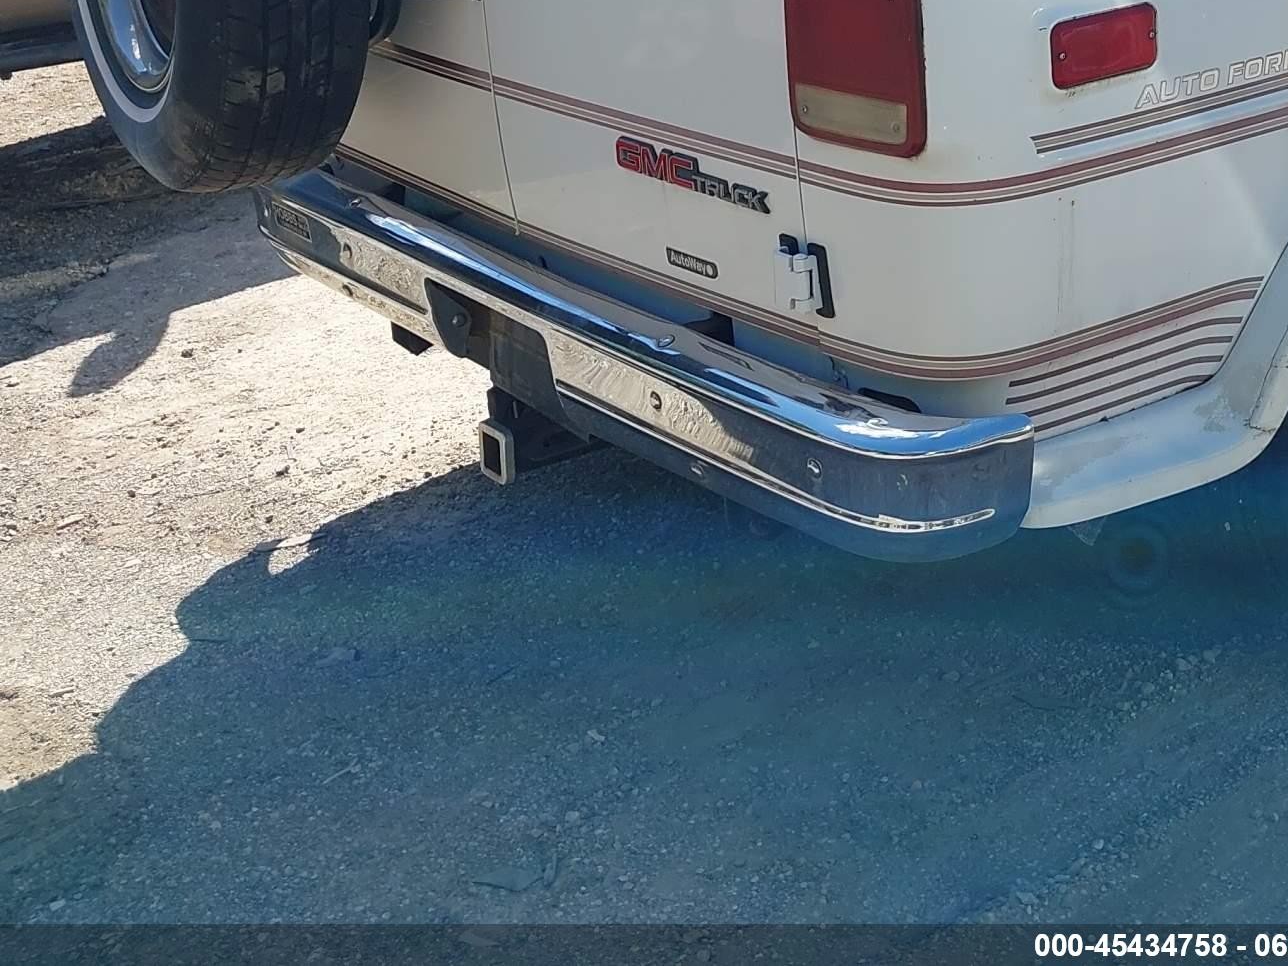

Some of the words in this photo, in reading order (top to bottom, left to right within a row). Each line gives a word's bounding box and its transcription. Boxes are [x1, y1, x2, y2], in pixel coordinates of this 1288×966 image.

[1135, 68, 1220, 109] AUTO
[615, 136, 697, 190] GMC
[691, 173, 771, 214] TRUCK
[669, 251, 709, 277] AutoWay
